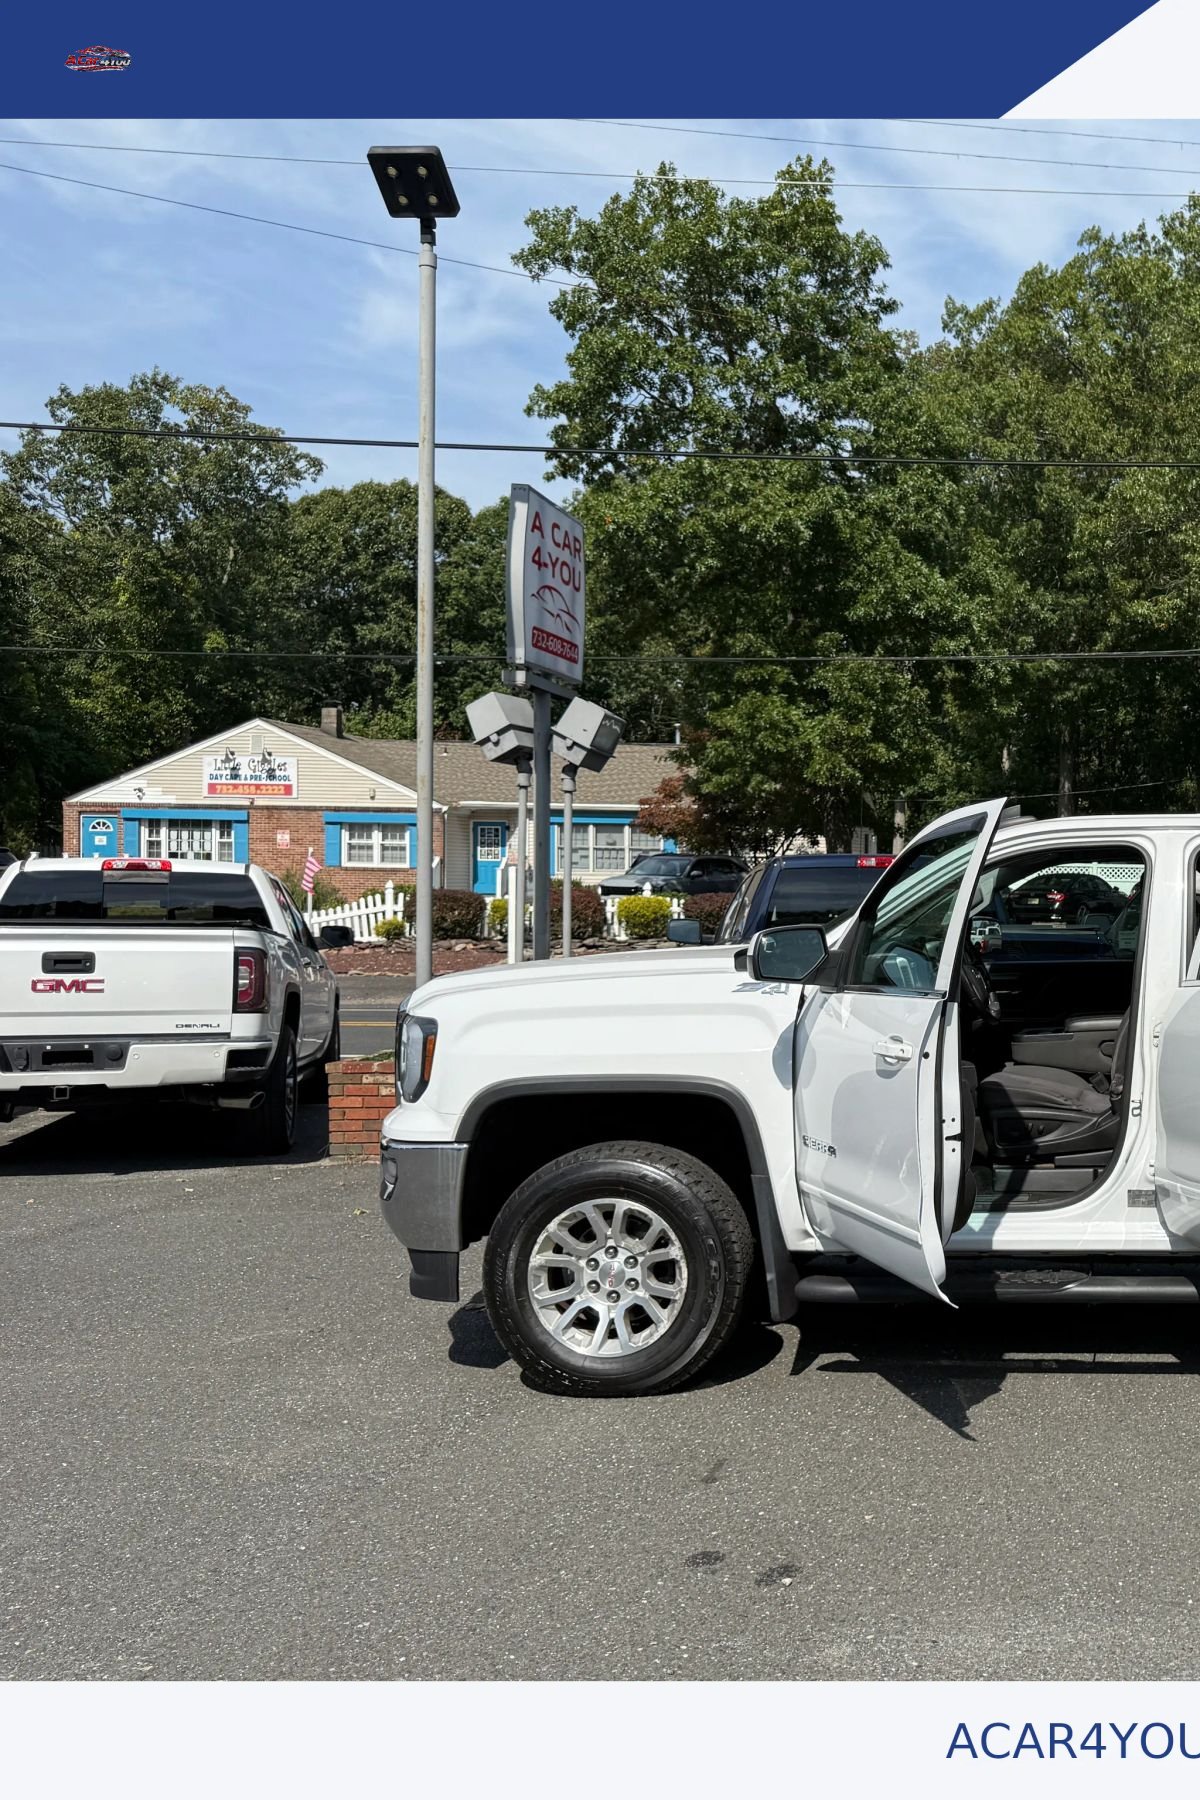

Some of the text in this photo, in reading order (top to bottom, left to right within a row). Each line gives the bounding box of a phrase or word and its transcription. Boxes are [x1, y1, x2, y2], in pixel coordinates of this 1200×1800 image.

[530, 511, 582, 563] A CAR
[208, 773, 224, 781] DAY
[249, 774, 292, 782] PRE-SCHOOL
[31, 979, 105, 993] GMC
